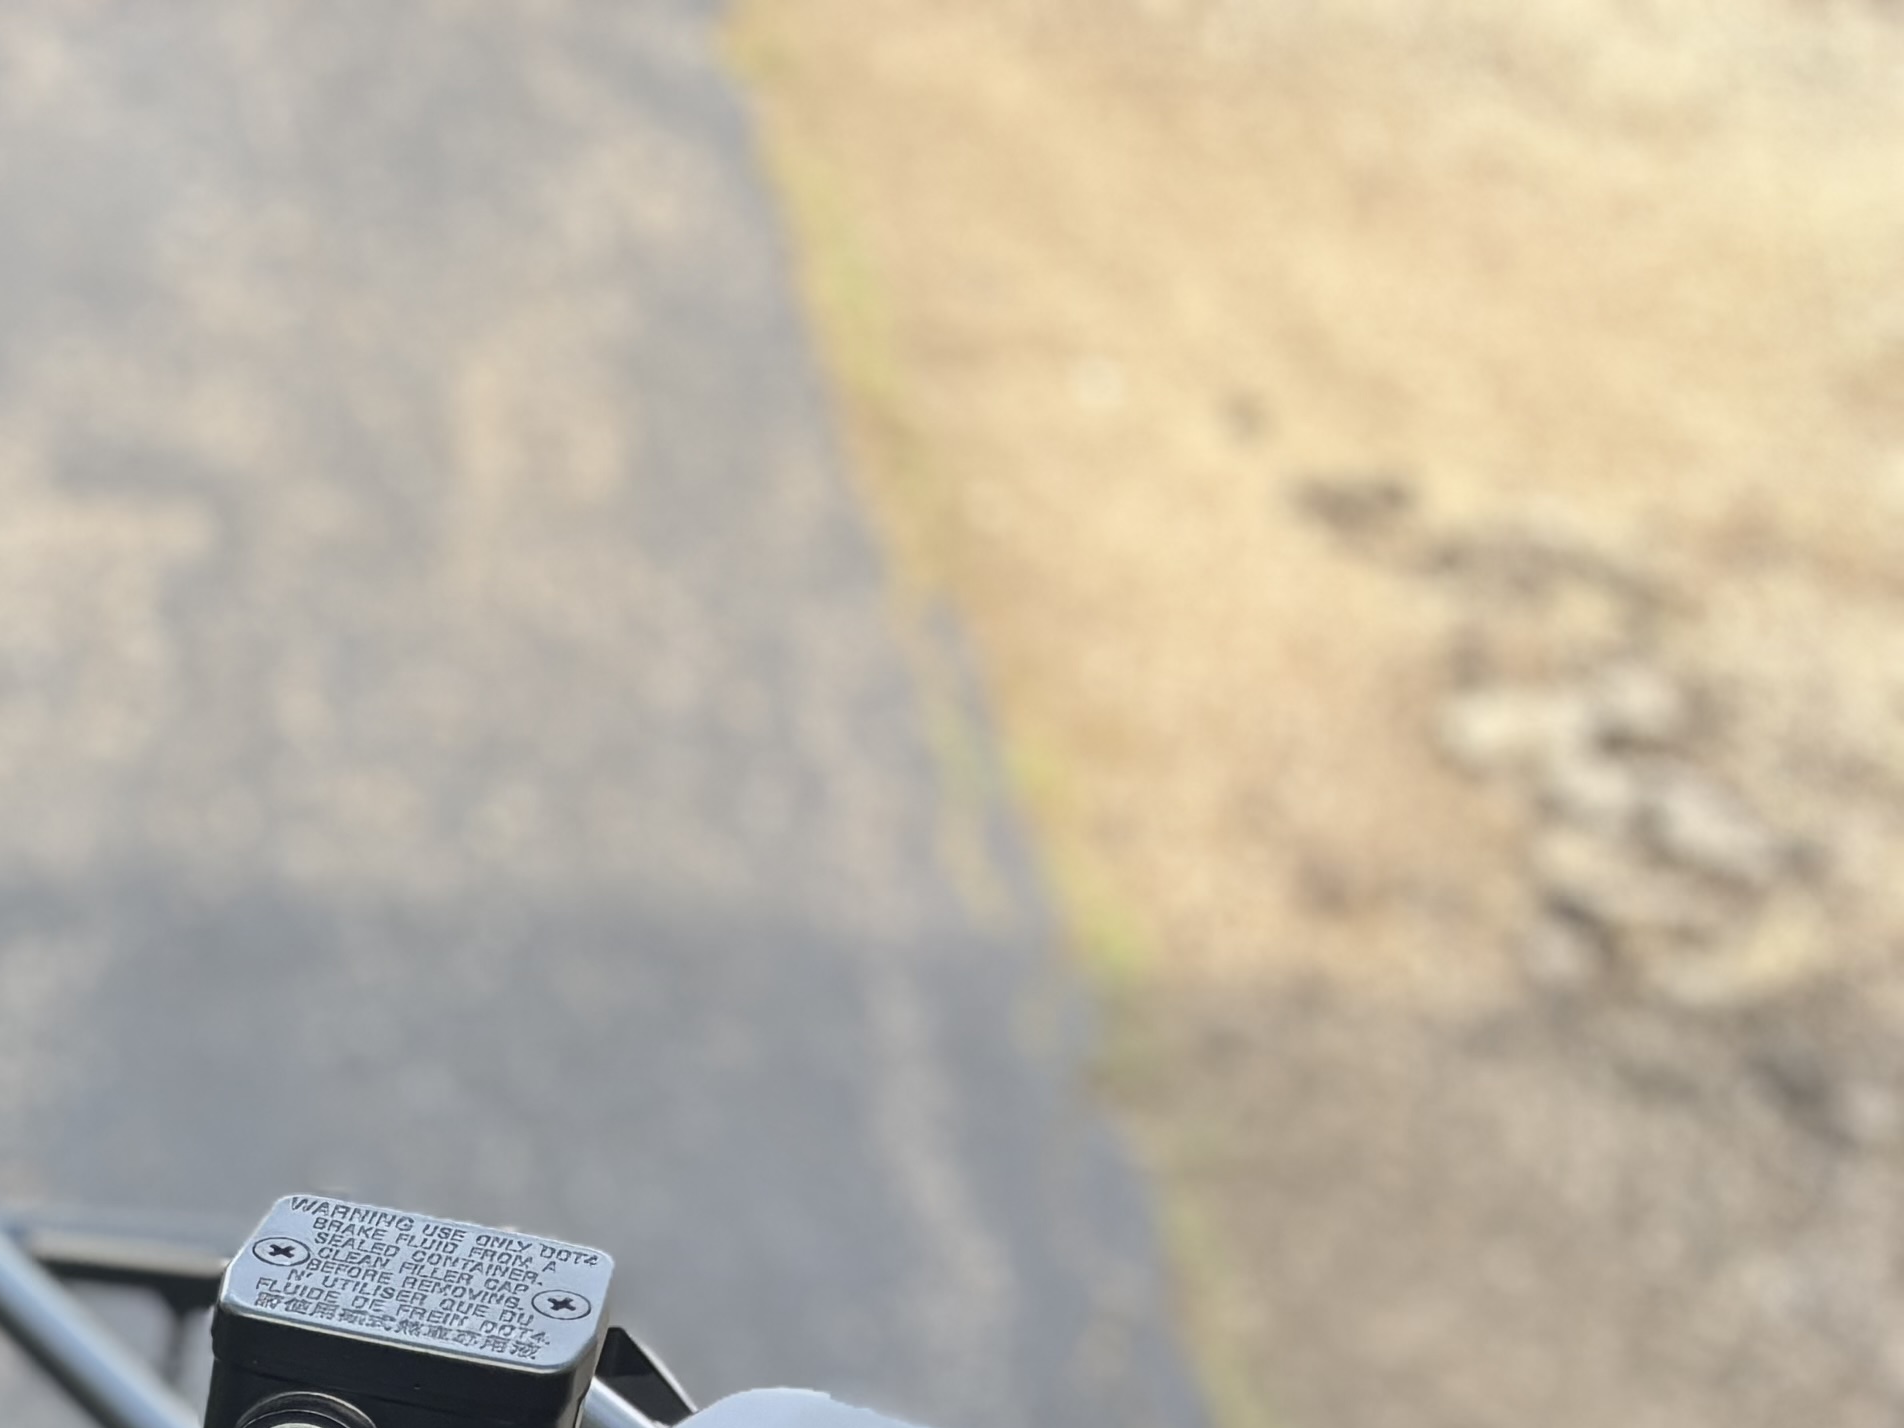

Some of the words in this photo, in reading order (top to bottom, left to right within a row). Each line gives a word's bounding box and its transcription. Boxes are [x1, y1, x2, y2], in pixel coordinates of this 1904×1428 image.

[292, 1197, 414, 1231] WARNING
[422, 1224, 467, 1242] USE
[476, 1234, 532, 1253] ONLY
[539, 1243, 599, 1266] DOT4
[313, 1217, 388, 1240] BRAKE
[395, 1233, 458, 1254] FLUID
[468, 1247, 533, 1269] FROM
[542, 1261, 556, 1273] A
[314, 1232, 400, 1256] SEALED
[306, 1258, 393, 1285] BEFORE
[318, 1247, 390, 1268] CLEAN
[399, 1261, 473, 1285] FILLER
[255, 1277, 341, 1303] FLUIDE
[351, 1296, 389, 1313] DE
[396, 1304, 468, 1327] FREIN
[322, 1275, 428, 1305] UTILISER
[439, 1298, 491, 1318] QUE
[499, 1310, 534, 1327] DU
